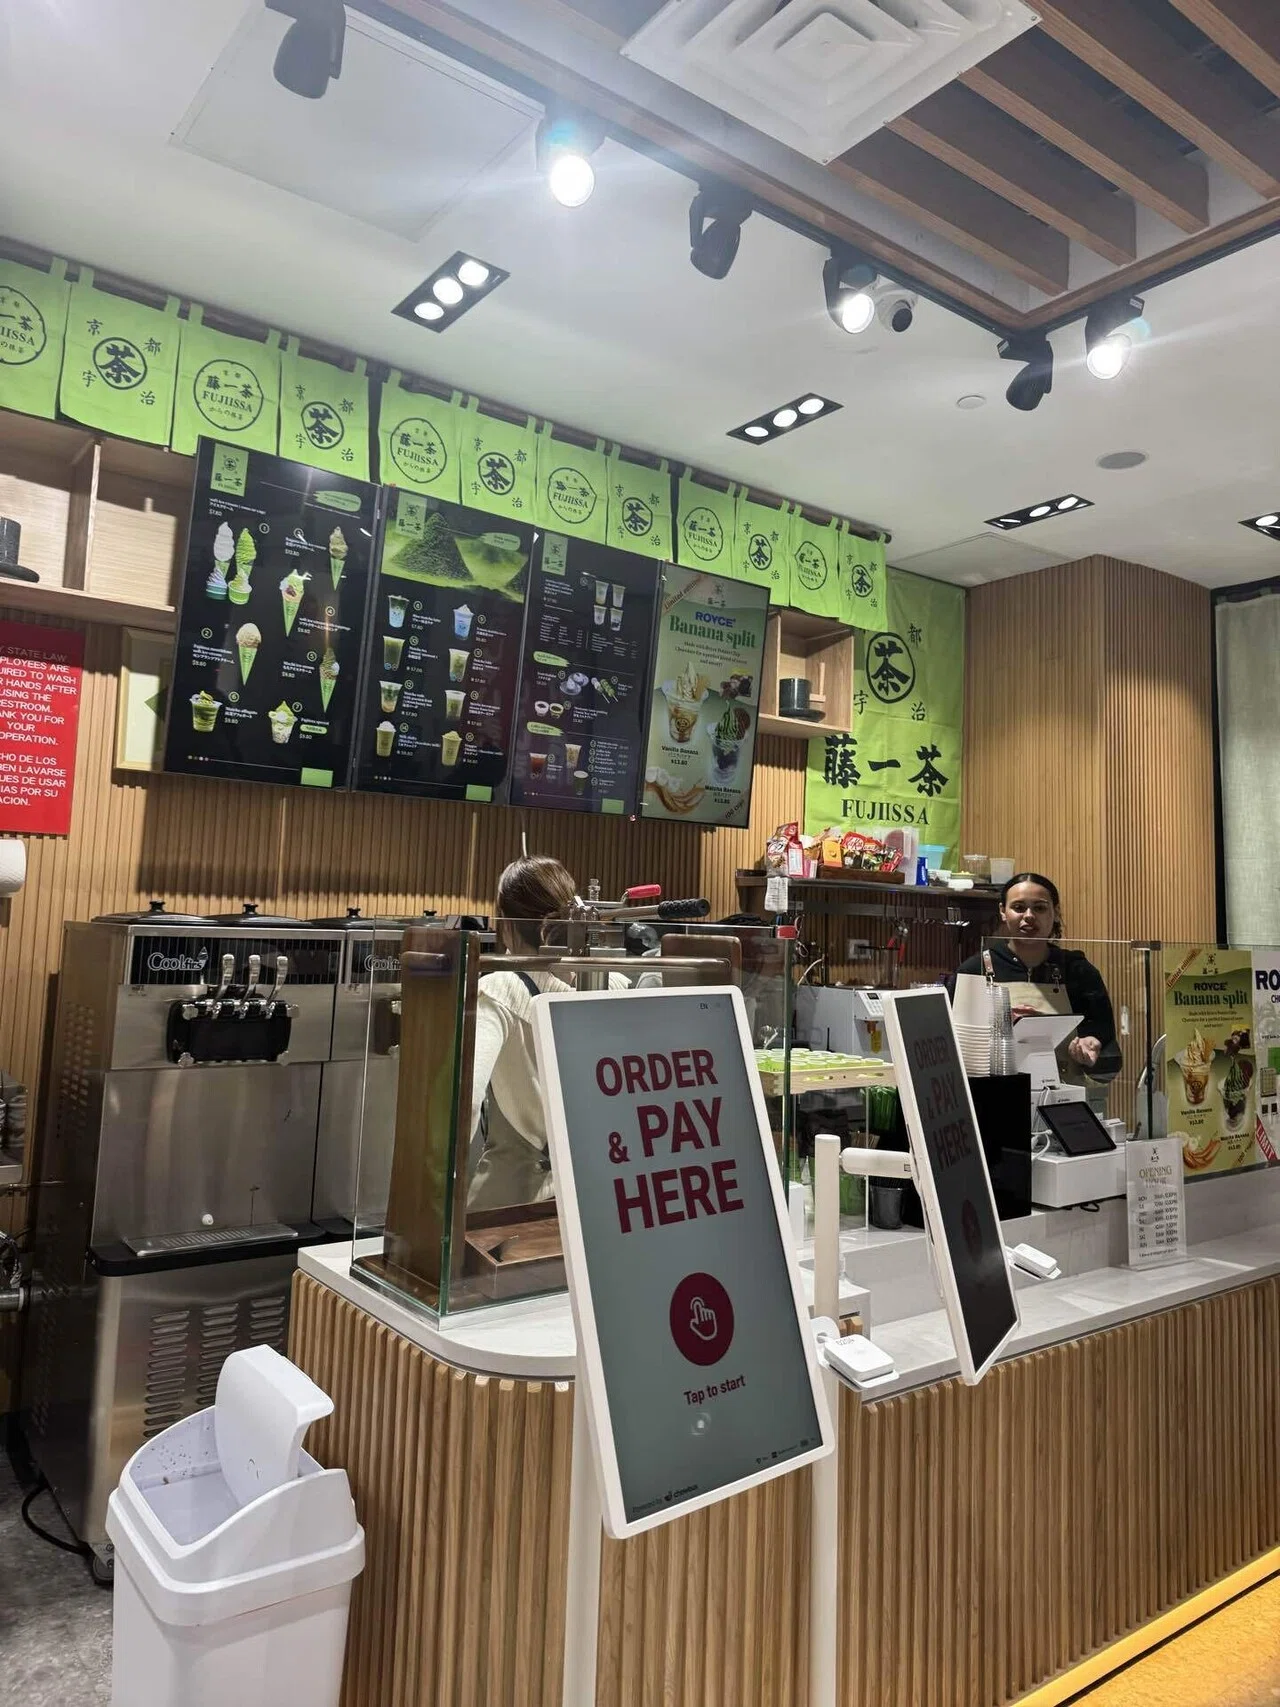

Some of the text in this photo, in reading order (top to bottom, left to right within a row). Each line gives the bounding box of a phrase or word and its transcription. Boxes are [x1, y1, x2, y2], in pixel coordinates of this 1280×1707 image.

[87, 319, 162, 356] 京 都
[98, 344, 141, 384] 茶
[82, 370, 155, 406] 宇 治
[206, 375, 254, 399] 藤一茶
[296, 384, 354, 414] 京 都
[202, 391, 252, 413] FUJIISSA
[307, 408, 339, 444] 茶
[296, 434, 354, 462] 宇 治
[474, 438, 527, 466] 京 都
[483, 457, 511, 490] 茶
[471, 480, 523, 508] 宇 治
[625, 502, 649, 532] 茶
[750, 538, 770, 566] 茶
[669, 614, 756, 650] Banana split
[908, 623, 923, 648] 都
[7, 646, 68, 662] STATE LAW
[50, 663, 70, 673] ARE
[870, 640, 911, 696] 茶
[6, 678, 42, 691] HANDS
[44, 682, 78, 696] AFTER
[30, 671, 44, 680] TO
[46, 673, 76, 684] WASH
[0, 699, 53, 714] ESTROOM.
[32, 692, 52, 702] THE
[853, 690, 927, 722] 宇 治
[6, 722, 36, 732] YOUR
[20, 712, 42, 723] YOU
[44, 715, 65, 726] FOR
[0, 752, 58, 766] HO DE LOS
[19, 765, 67, 778] LAVARSE
[823, 733, 950, 798] 藤一茶
[20, 787, 42, 797] POR
[44, 789, 59, 798] SU
[22, 776, 37, 785] DE
[38, 778, 66, 788] USAR
[841, 798, 930, 826] FUJIISSA
[1174, 989, 1248, 1009] Banana split
[914, 1036, 948, 1070] ORDER
[595, 1048, 719, 1097] ORDER
[930, 1071, 960, 1114] PAY
[608, 1096, 722, 1165] & PAY
[932, 1118, 971, 1172] HERE
[613, 1158, 745, 1234] HERE
[684, 1374, 747, 1406] Tap to start
